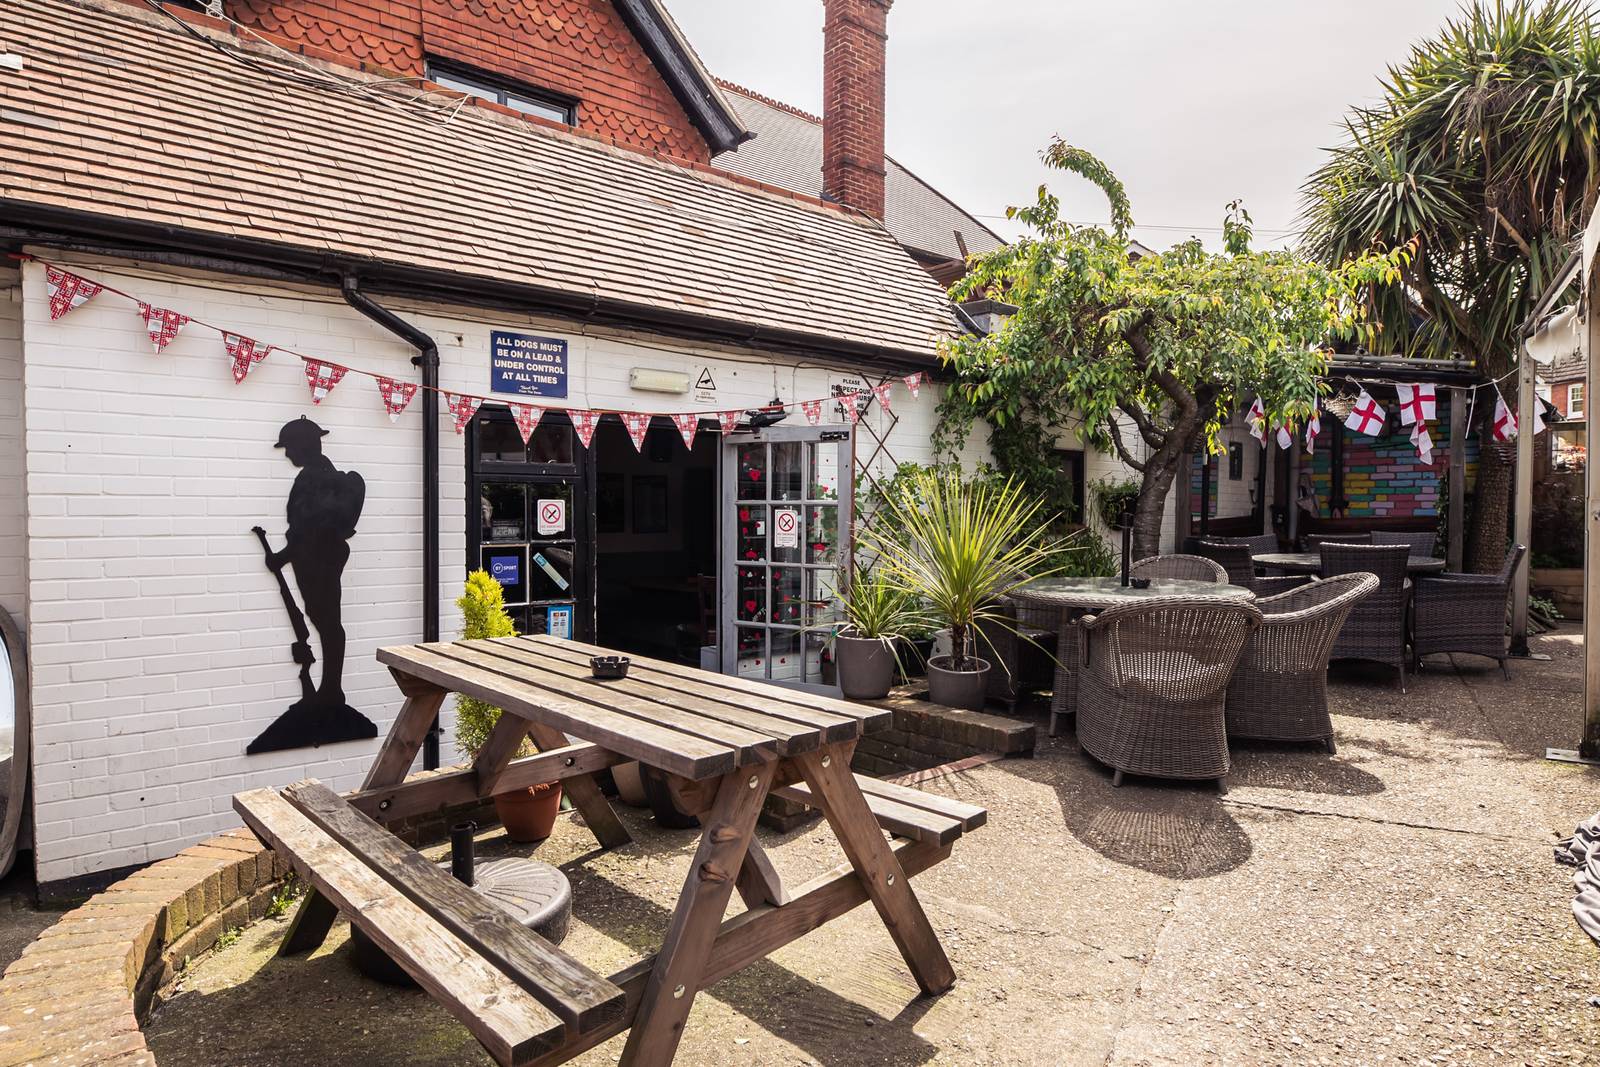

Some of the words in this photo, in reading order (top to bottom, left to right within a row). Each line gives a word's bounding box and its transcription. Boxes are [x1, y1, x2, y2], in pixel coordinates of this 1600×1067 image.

[496, 337, 512, 346] ALL
[514, 339, 538, 349] DOGS
[540, 342, 563, 352] MUST
[497, 348, 509, 357] BE
[510, 350, 523, 358] ON
[532, 353, 553, 362] LEAD
[555, 355, 562, 363] &
[494, 360, 524, 370] UNDER
[526, 363, 565, 374] CONTROL
[502, 372, 514, 380] AT
[515, 373, 531, 381] ALL
[533, 375, 558, 384] TIMES
